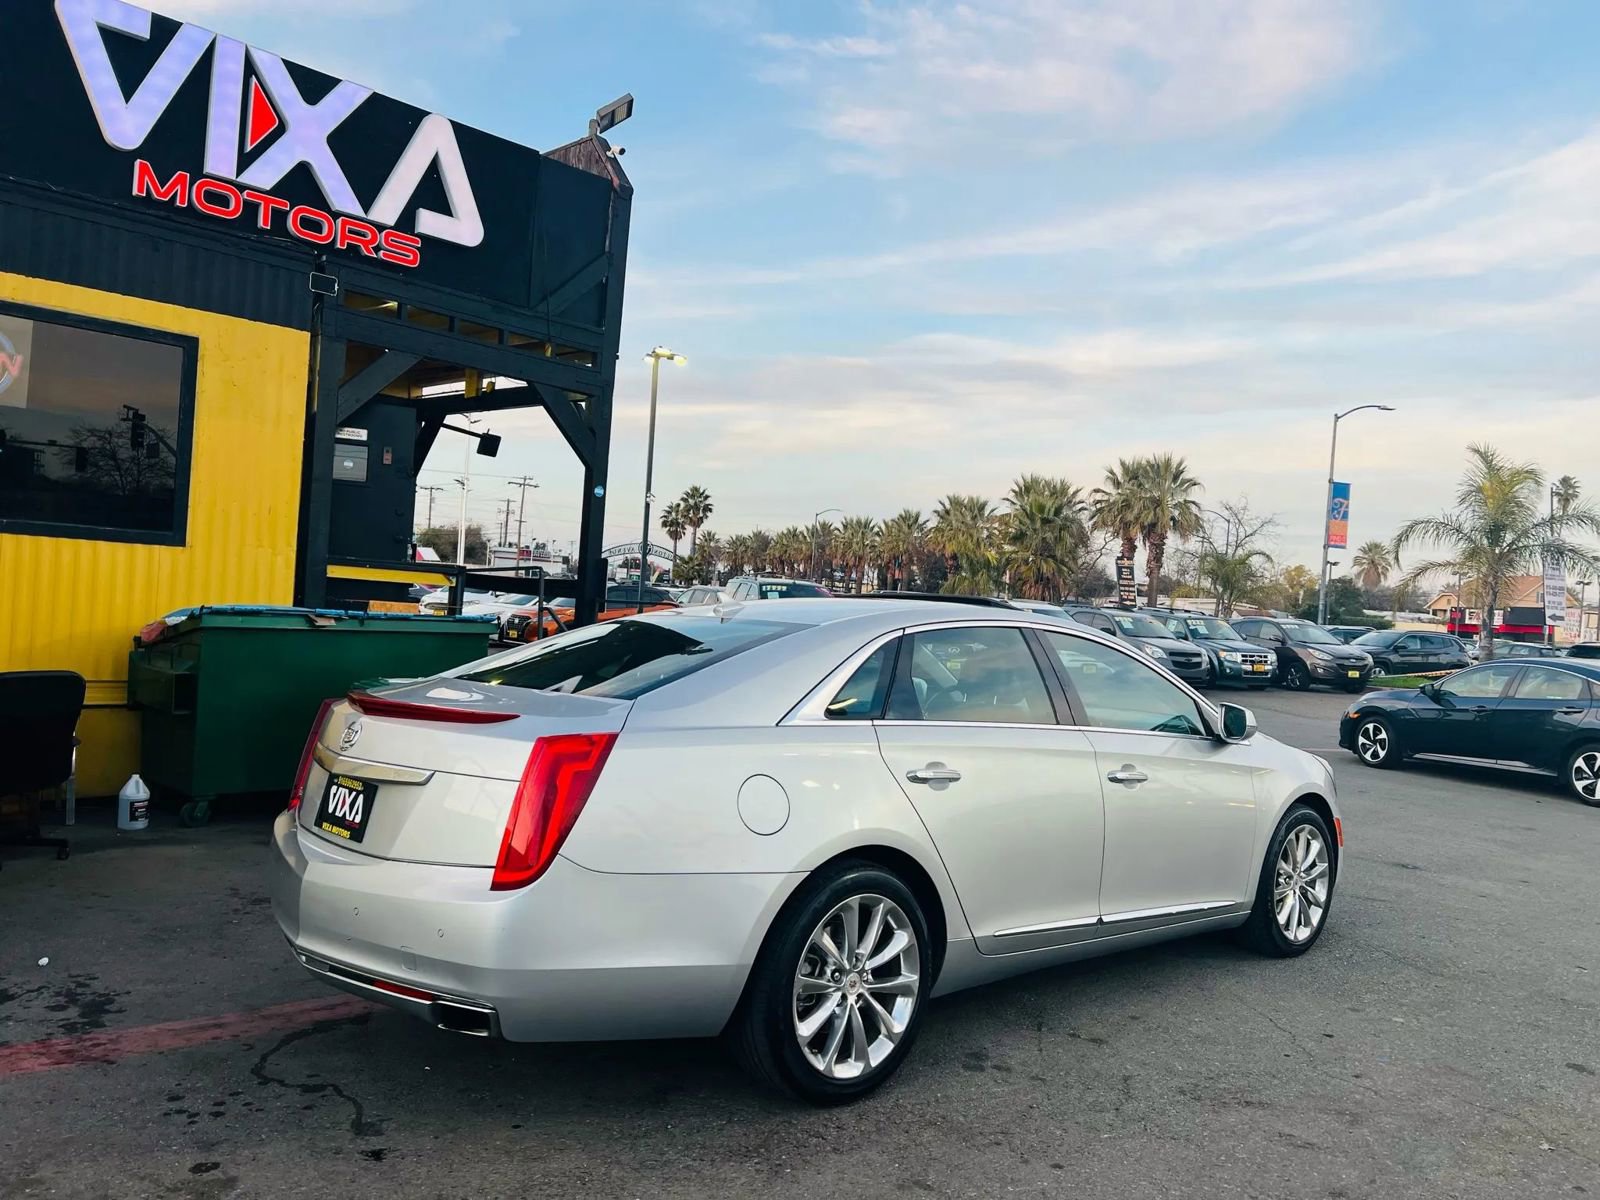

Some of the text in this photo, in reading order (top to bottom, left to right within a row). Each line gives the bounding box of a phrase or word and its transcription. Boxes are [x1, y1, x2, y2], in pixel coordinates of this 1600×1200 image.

[54, 0, 484, 248] VIXA
[132, 159, 422, 268] MOTORS
[322, 822, 332, 832] VIXA
[332, 826, 351, 838] MOTORS
[328, 784, 364, 824] VIXA
